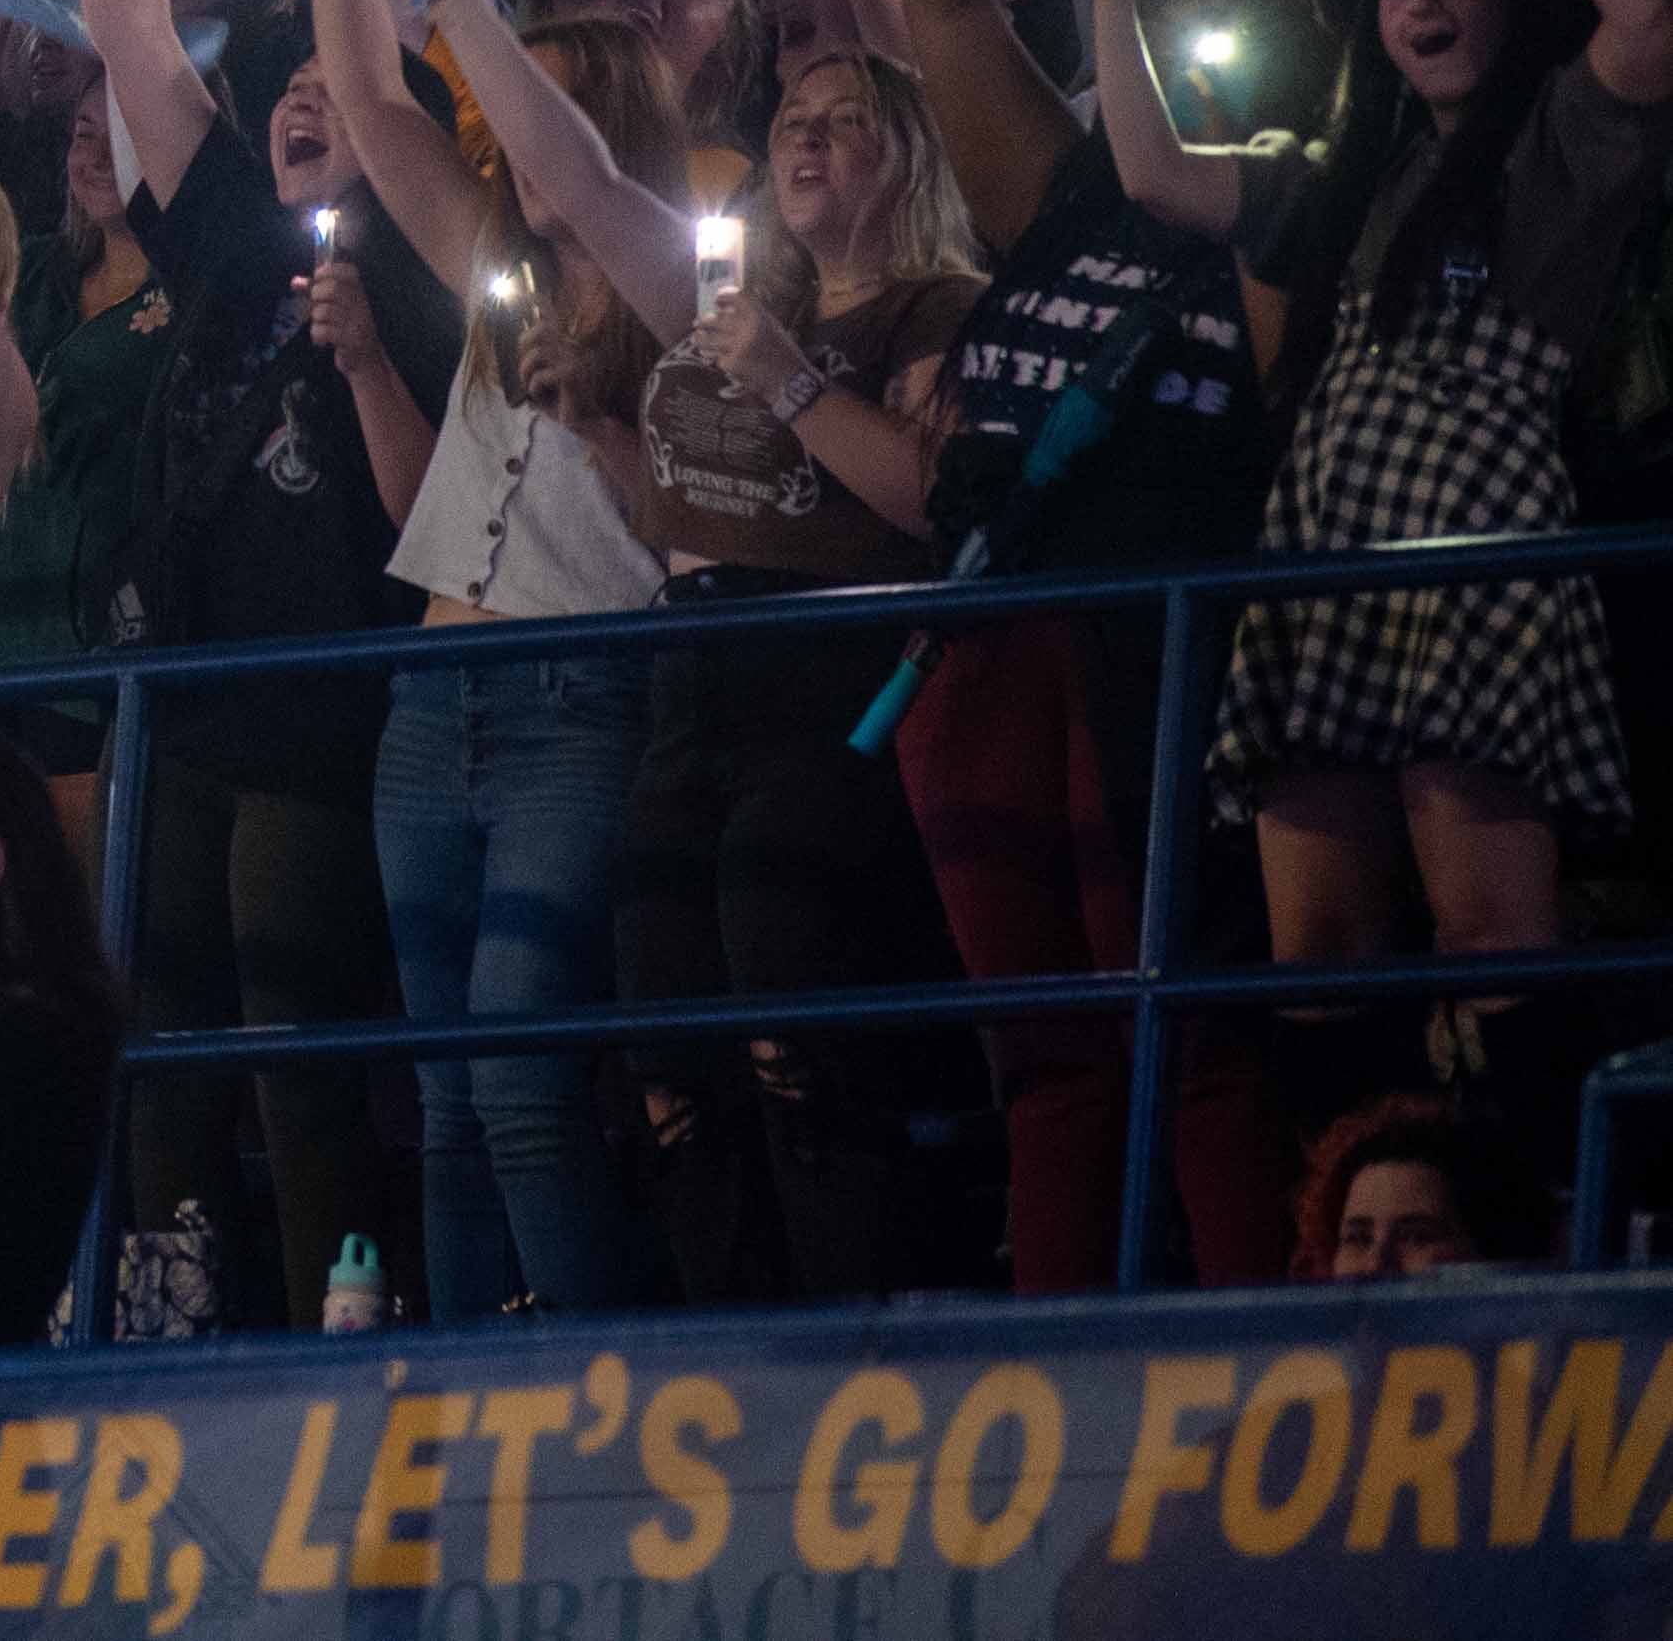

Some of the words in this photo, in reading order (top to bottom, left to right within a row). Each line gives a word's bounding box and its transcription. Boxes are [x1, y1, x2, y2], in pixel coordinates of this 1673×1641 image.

[260, 1354, 746, 1591] LET'S
[792, 1368, 1066, 1572] GO
[1107, 1337, 1673, 1562] FORW
